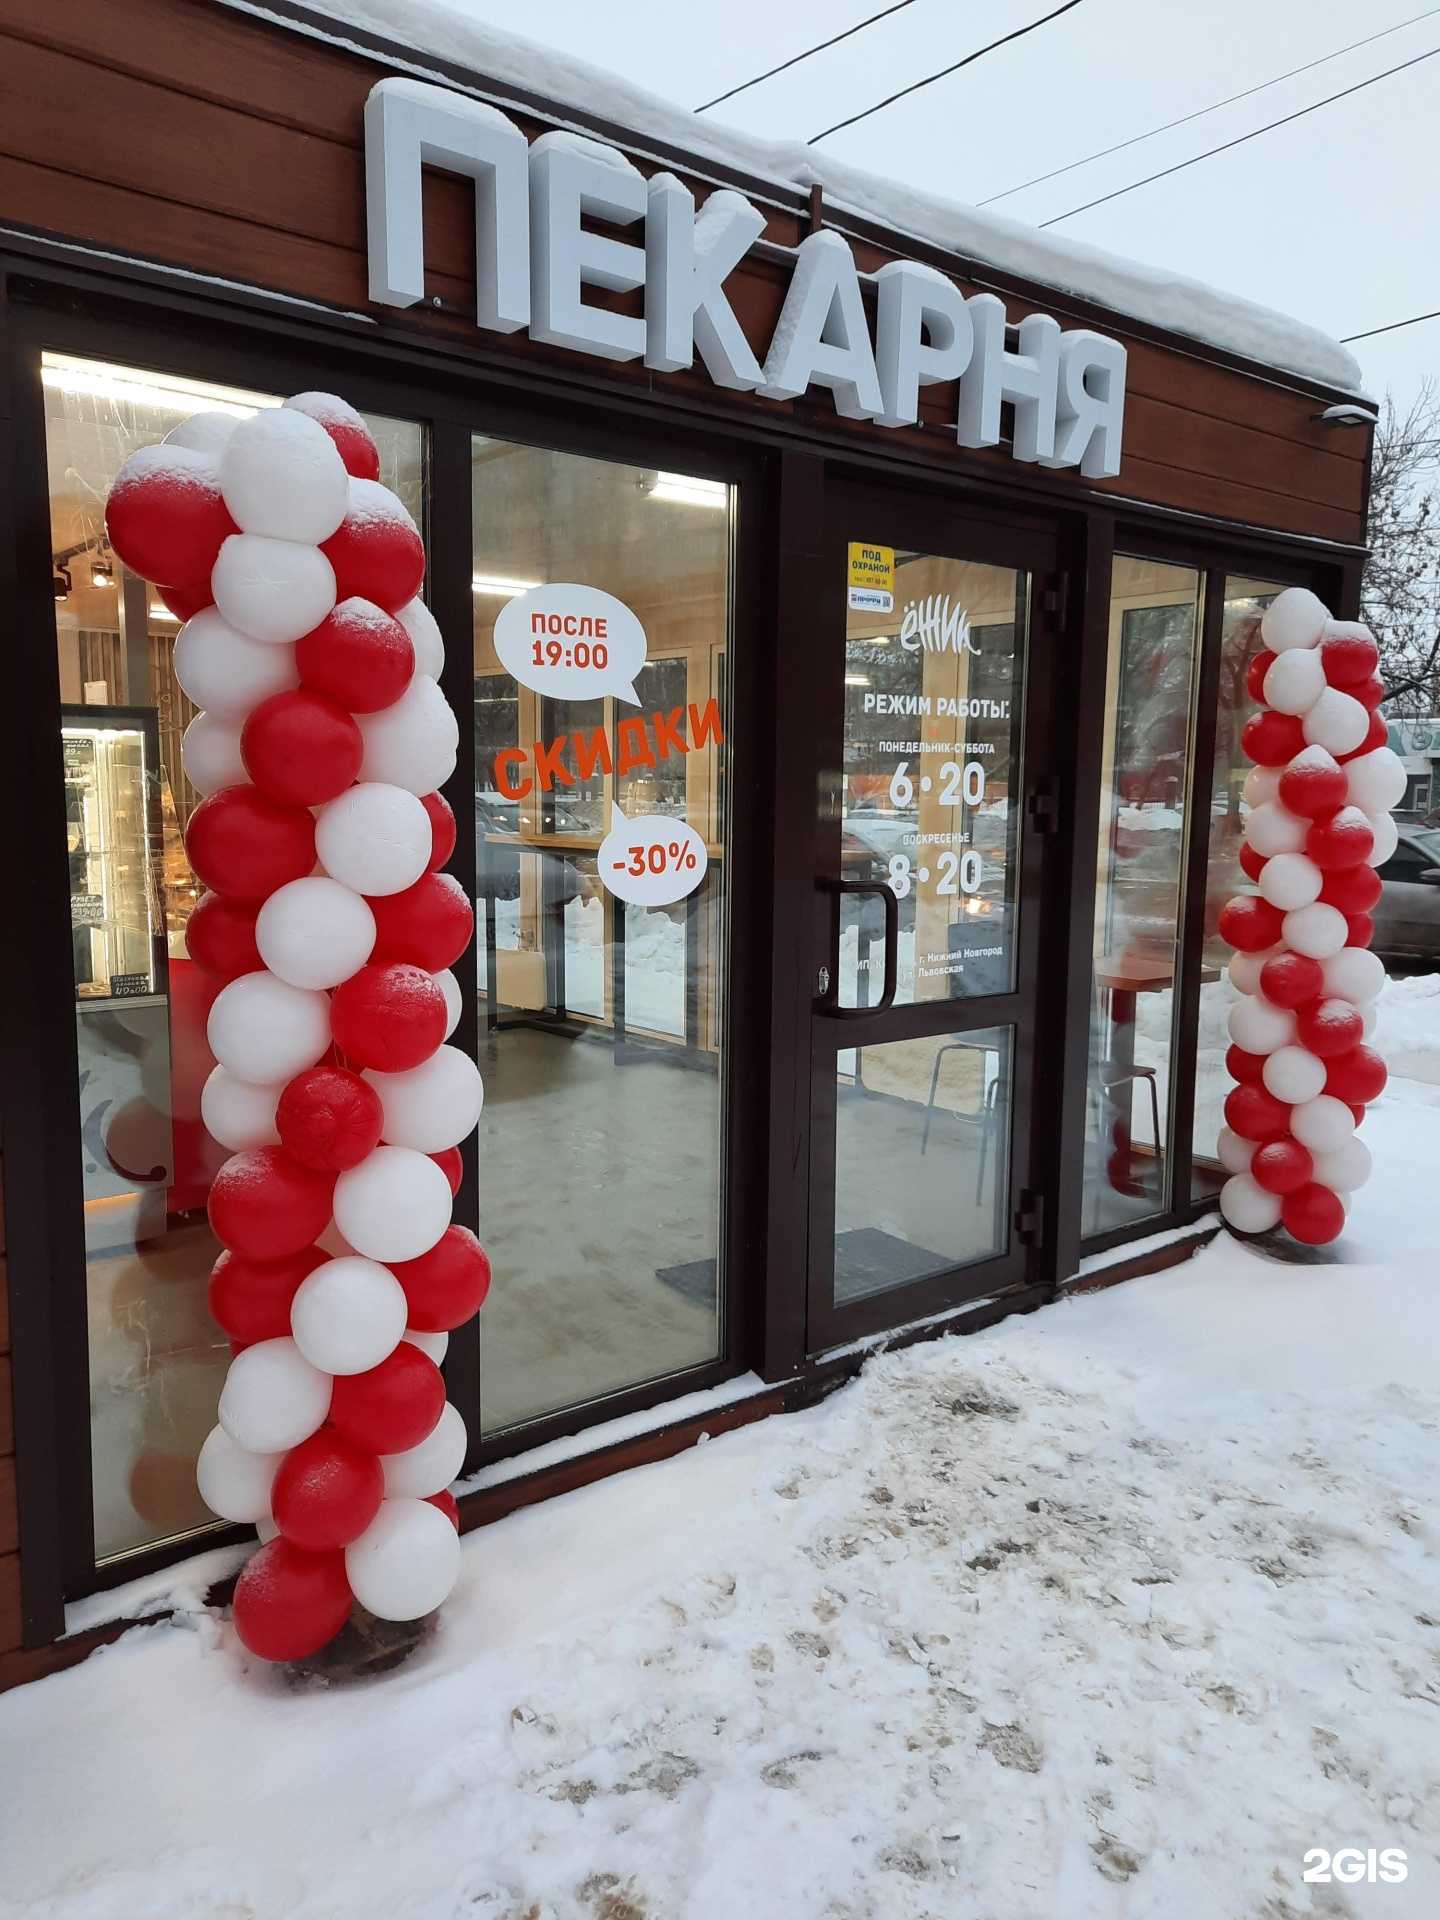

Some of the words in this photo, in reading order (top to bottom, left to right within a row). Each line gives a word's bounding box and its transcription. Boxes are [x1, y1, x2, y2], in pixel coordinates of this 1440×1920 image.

[364, 77, 1127, 478] ПЕКАРНЯ
[862, 550, 882, 562] ПОД
[531, 613, 608, 638] ПОСЛЕ
[532, 639, 609, 669] 19:00
[864, 693, 931, 715] РЕЖИМ
[936, 697, 1011, 719] РАБОТЫ:
[494, 697, 725, 801] СКИДКИ
[902, 832, 970, 846] ВОСКРЕСЕНЬЕ
[612, 840, 697, 877] -30%
[927, 951, 962, 962] Нижний
[963, 946, 1003, 958] Новгород
[918, 965, 964, 977] Львовская
